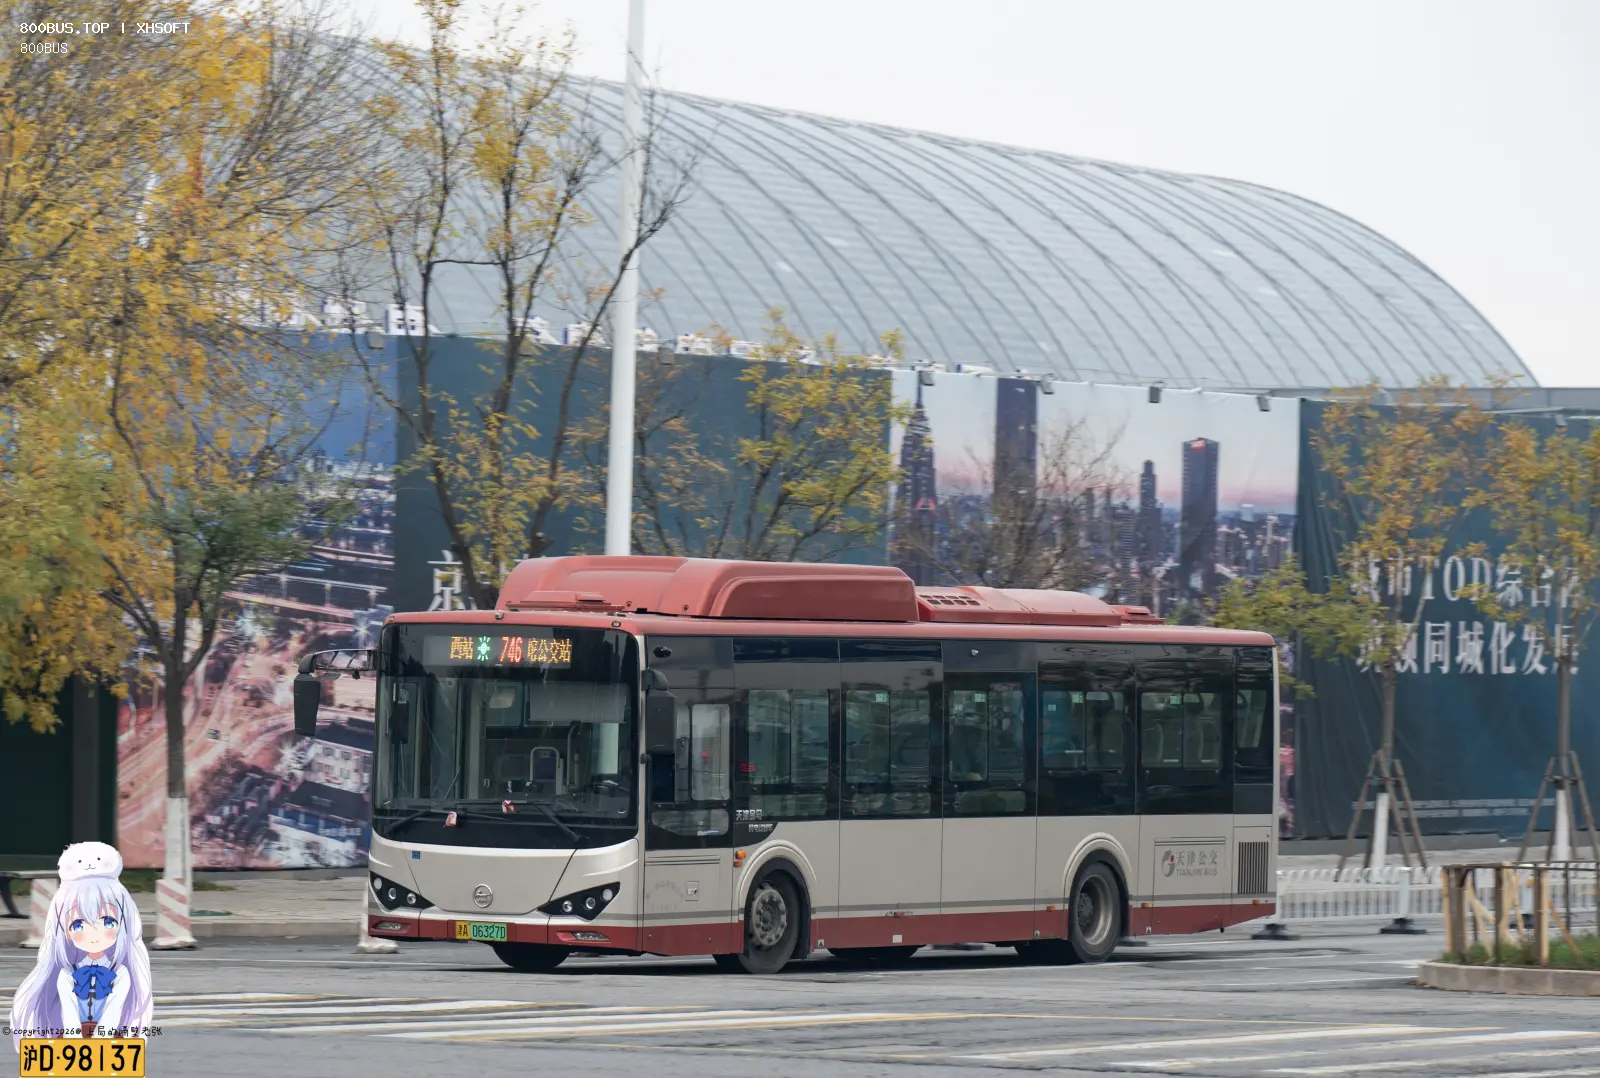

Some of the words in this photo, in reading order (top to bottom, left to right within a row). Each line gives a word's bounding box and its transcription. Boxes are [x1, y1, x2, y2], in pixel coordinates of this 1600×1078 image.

[499, 636, 523, 662] 746
[1176, 849, 1218, 866] 天津公交
[1176, 867, 1202, 878] TIANJIN
[1204, 867, 1218, 876] BUS
